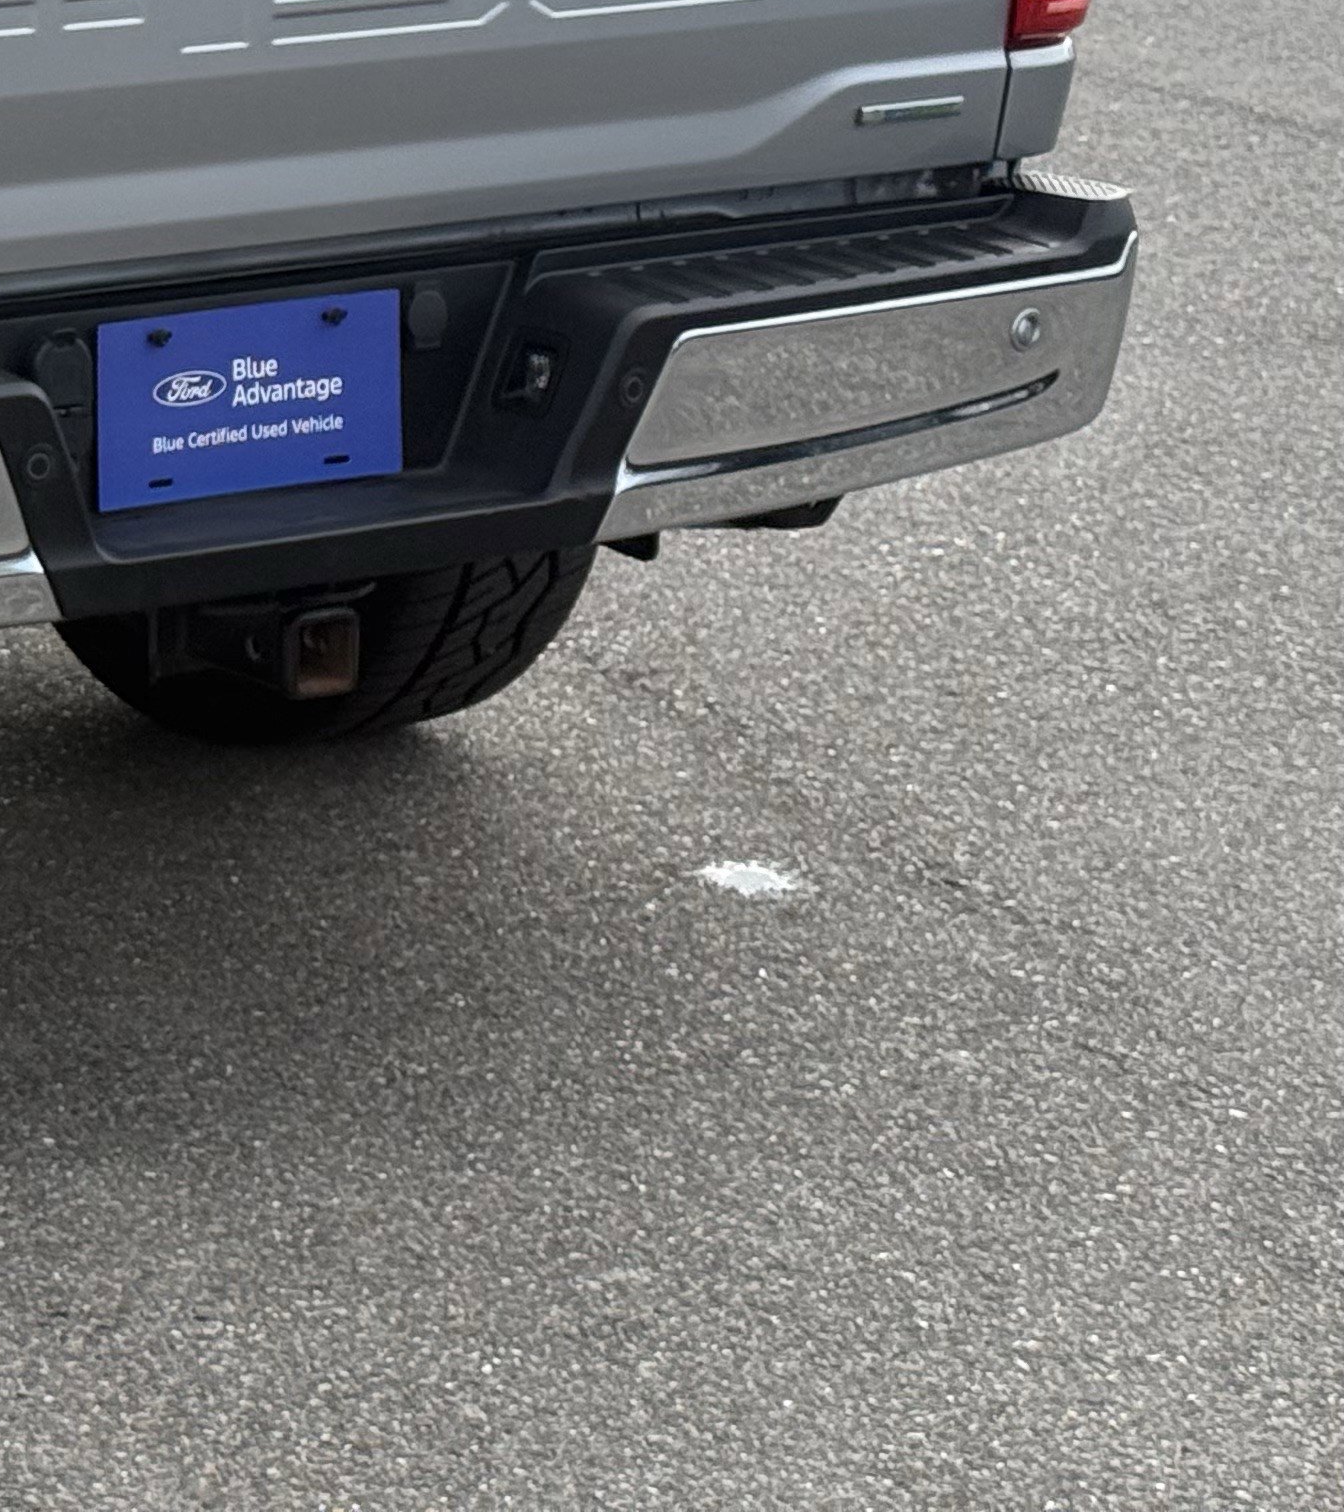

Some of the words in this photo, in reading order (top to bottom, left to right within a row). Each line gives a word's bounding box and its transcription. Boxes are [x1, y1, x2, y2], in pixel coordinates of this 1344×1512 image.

[232, 356, 279, 382] Blue
[167, 376, 214, 402] Ford
[232, 375, 343, 408] Advantage
[153, 436, 185, 455] Blue
[188, 426, 248, 450] Certified
[252, 420, 288, 440] Used
[292, 414, 344, 435] Vehicle
